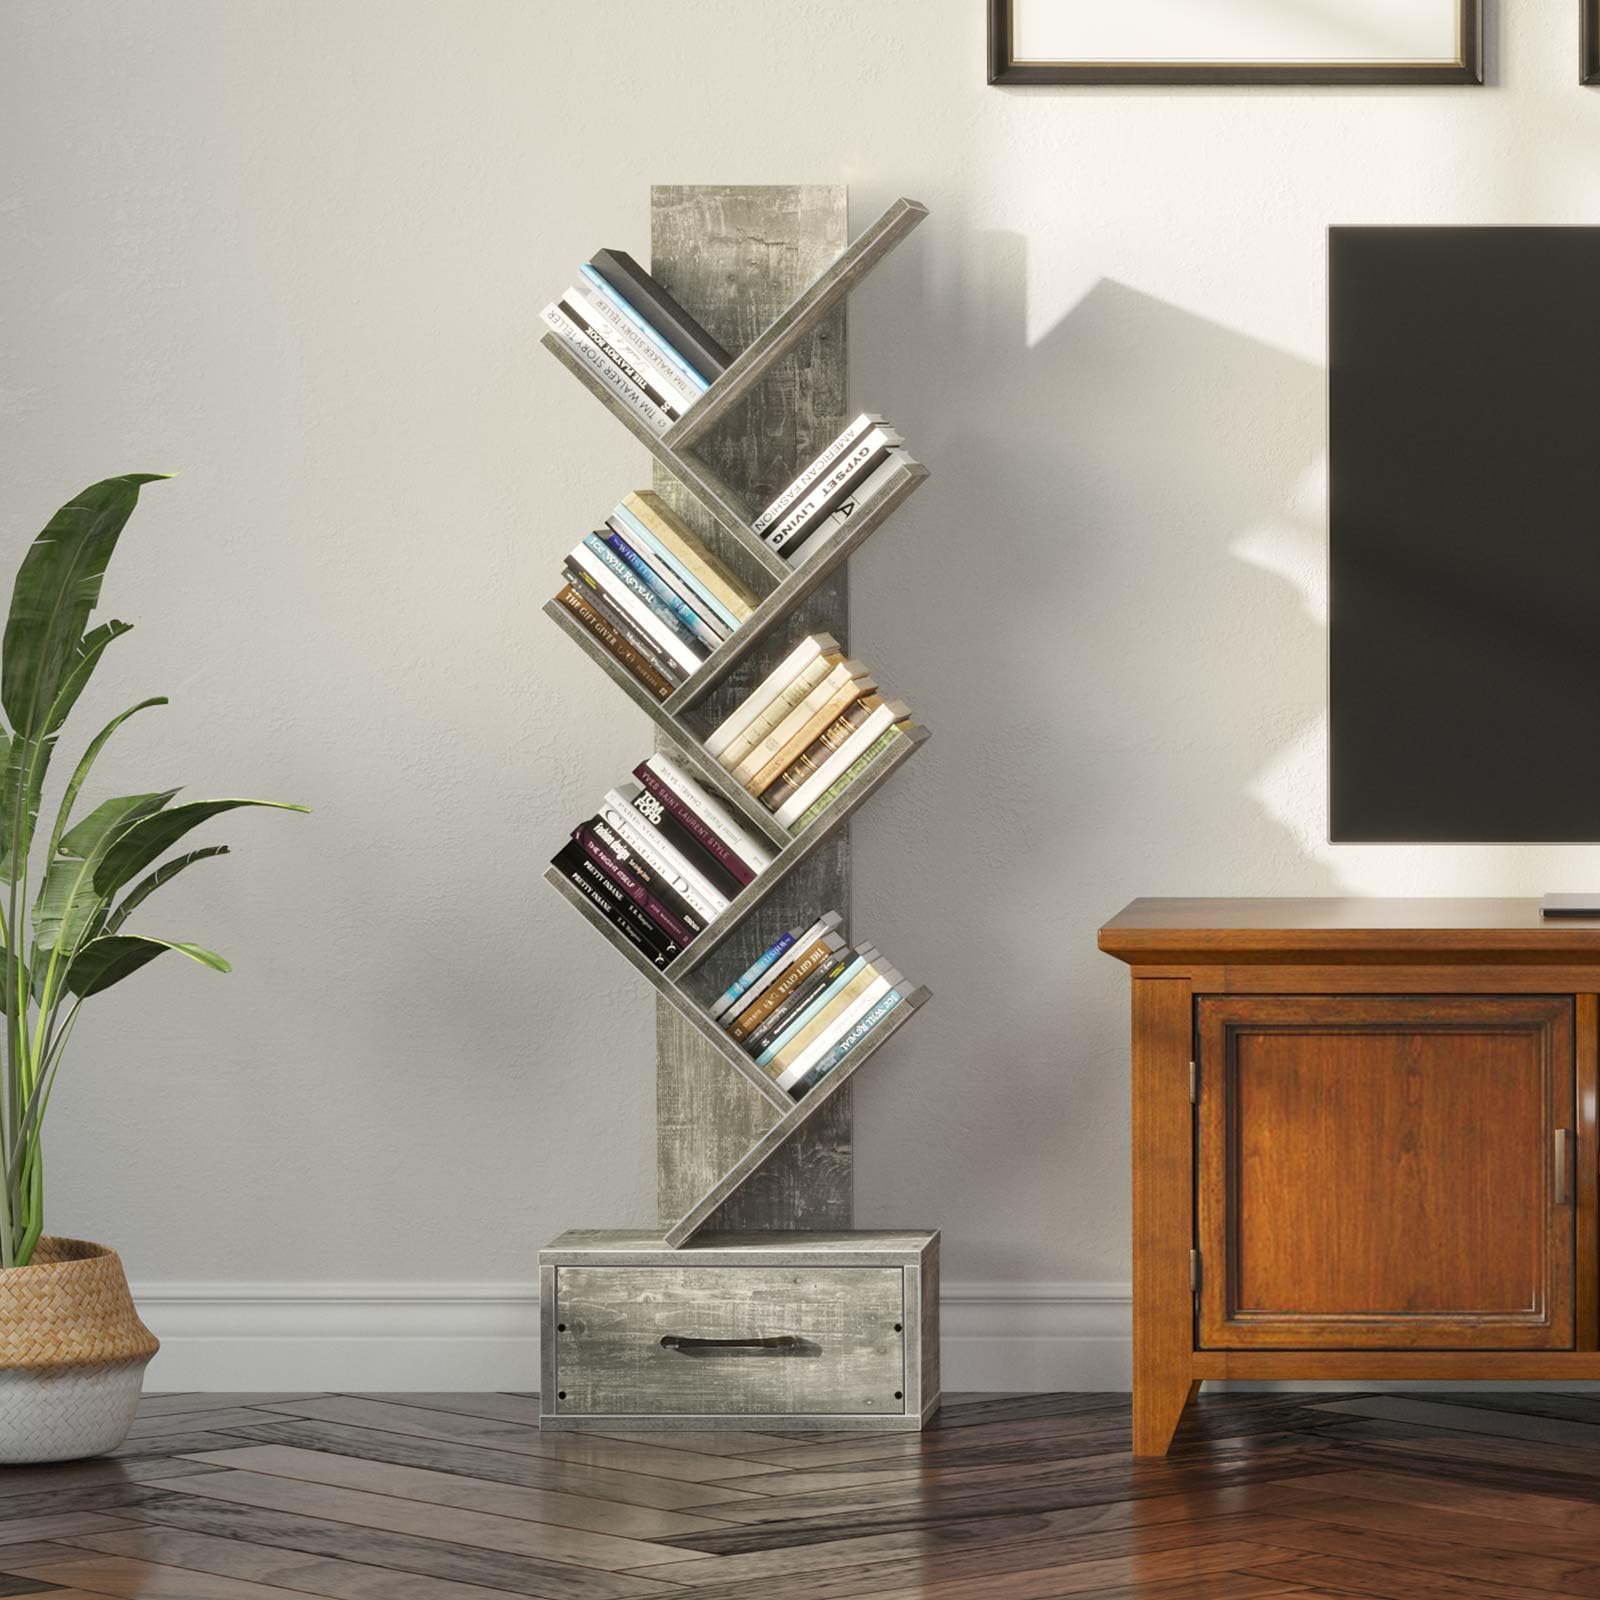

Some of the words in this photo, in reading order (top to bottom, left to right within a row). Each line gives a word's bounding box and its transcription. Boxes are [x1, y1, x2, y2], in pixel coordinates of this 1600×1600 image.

[546, 309, 578, 341] TELLER
[595, 298, 621, 324] TELLER
[585, 325, 605, 347] BOOK
[619, 322, 645, 348] STORY
[575, 337, 605, 368] STORY
[603, 343, 635, 376] PLAYBOY
[643, 345, 674, 377] WALKER
[602, 364, 641, 403] WALKER
[631, 372, 648, 389] THE
[638, 400, 656, 419] TIM
[800, 428, 856, 485] AMERICAN
[819, 445, 870, 497] GYPSET
[754, 483, 801, 531] FASHION
[771, 501, 815, 545] LIVING
[564, 592, 581, 609] THE
[578, 605, 597, 624] GIFT
[594, 621, 618, 645] GIVER
[633, 797, 661, 825] FORD
[640, 790, 664, 815] TOM
[640, 772, 659, 790] YVES
[657, 788, 679, 810] SAINT
[677, 808, 708, 839] LAURENT
[706, 836, 729, 859] STYLE
[592, 821, 615, 846] Fashion
[609, 838, 630, 863] design
[586, 840, 600, 854] THE
[597, 851, 618, 873] NIGHT
[615, 869, 635, 890] ITSELF
[601, 806, 667, 874] Christian
[670, 874, 705, 913] Dior
[570, 872, 592, 894] PRETTY
[589, 890, 612, 913] INSANE
[582, 860, 604, 882] PRETTY
[601, 879, 624, 901] INSANE
[795, 959, 812, 976] GIFT
[808, 947, 824, 963] THE
[778, 972, 798, 994] GIVER
